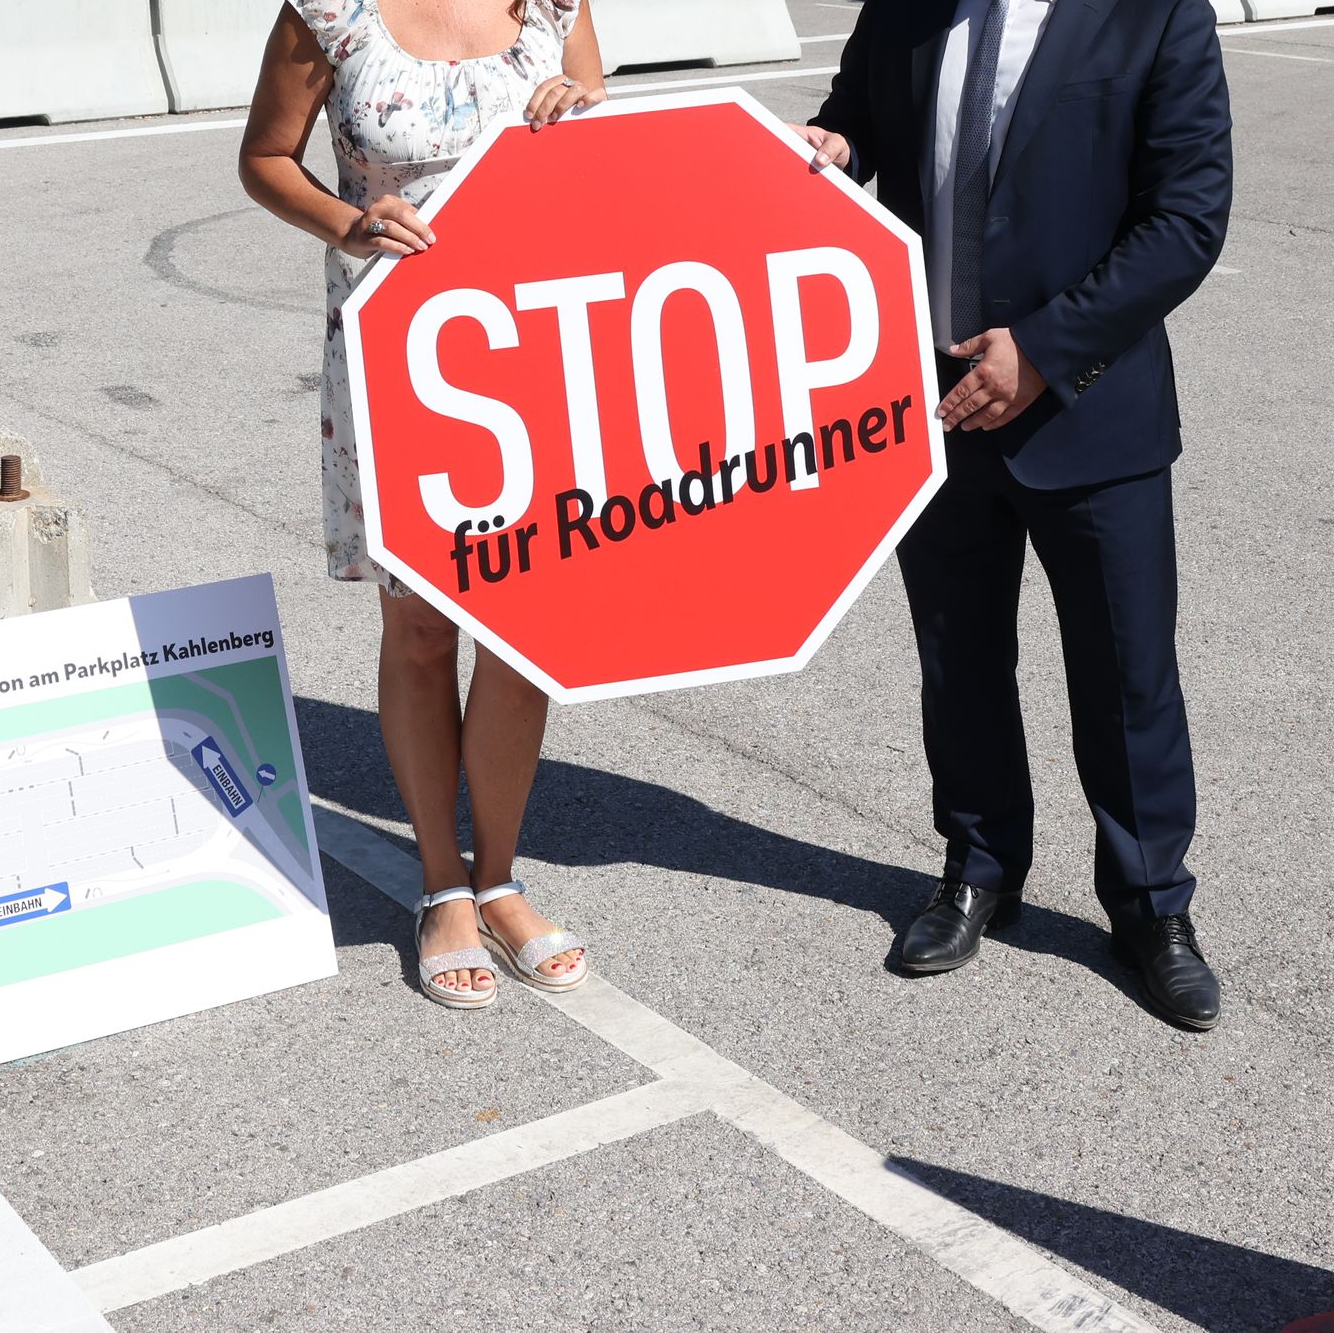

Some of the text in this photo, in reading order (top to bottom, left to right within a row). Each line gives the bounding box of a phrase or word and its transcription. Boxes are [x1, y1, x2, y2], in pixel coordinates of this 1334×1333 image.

[406, 246, 880, 535] STOP
[450, 394, 913, 593] für Roadrunner
[29, 671, 60, 688] am
[63, 652, 160, 681] Parkplatz
[162, 629, 275, 663] Kahlenberg
[212, 764, 243, 807] EINBAHN
